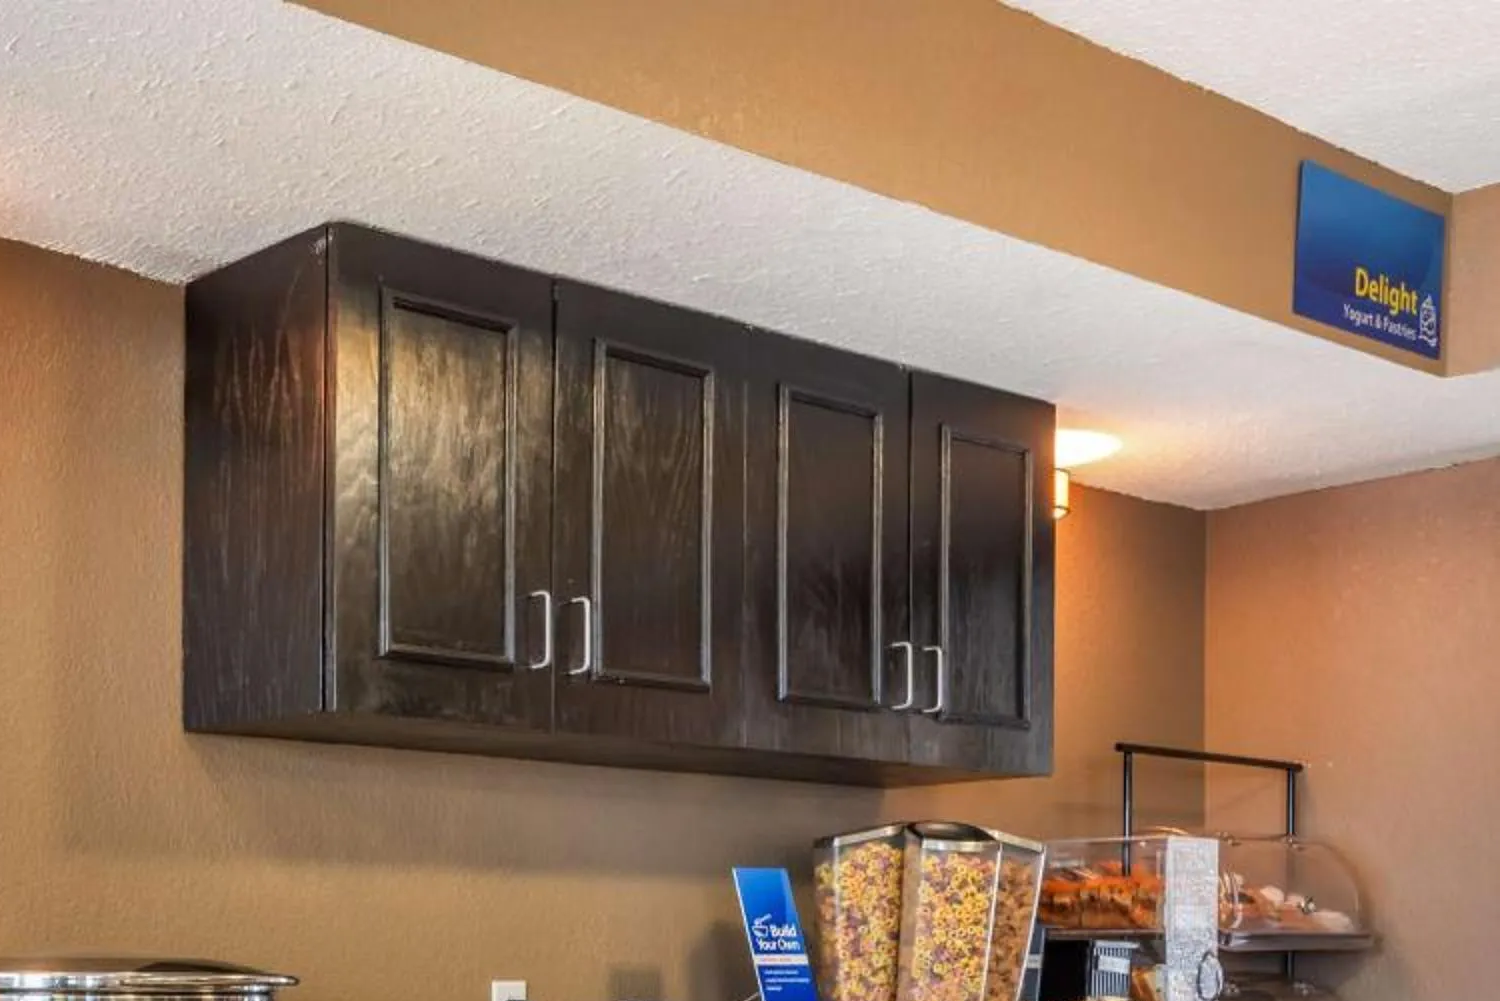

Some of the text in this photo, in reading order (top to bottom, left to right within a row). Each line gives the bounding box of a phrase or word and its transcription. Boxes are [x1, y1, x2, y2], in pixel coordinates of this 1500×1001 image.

[1355, 267, 1418, 316] Delight
[1343, 303, 1373, 327] Yogurt
[1383, 316, 1417, 341] Pastries
[755, 937, 801, 951] Your Own
[769, 924, 797, 938] Build
